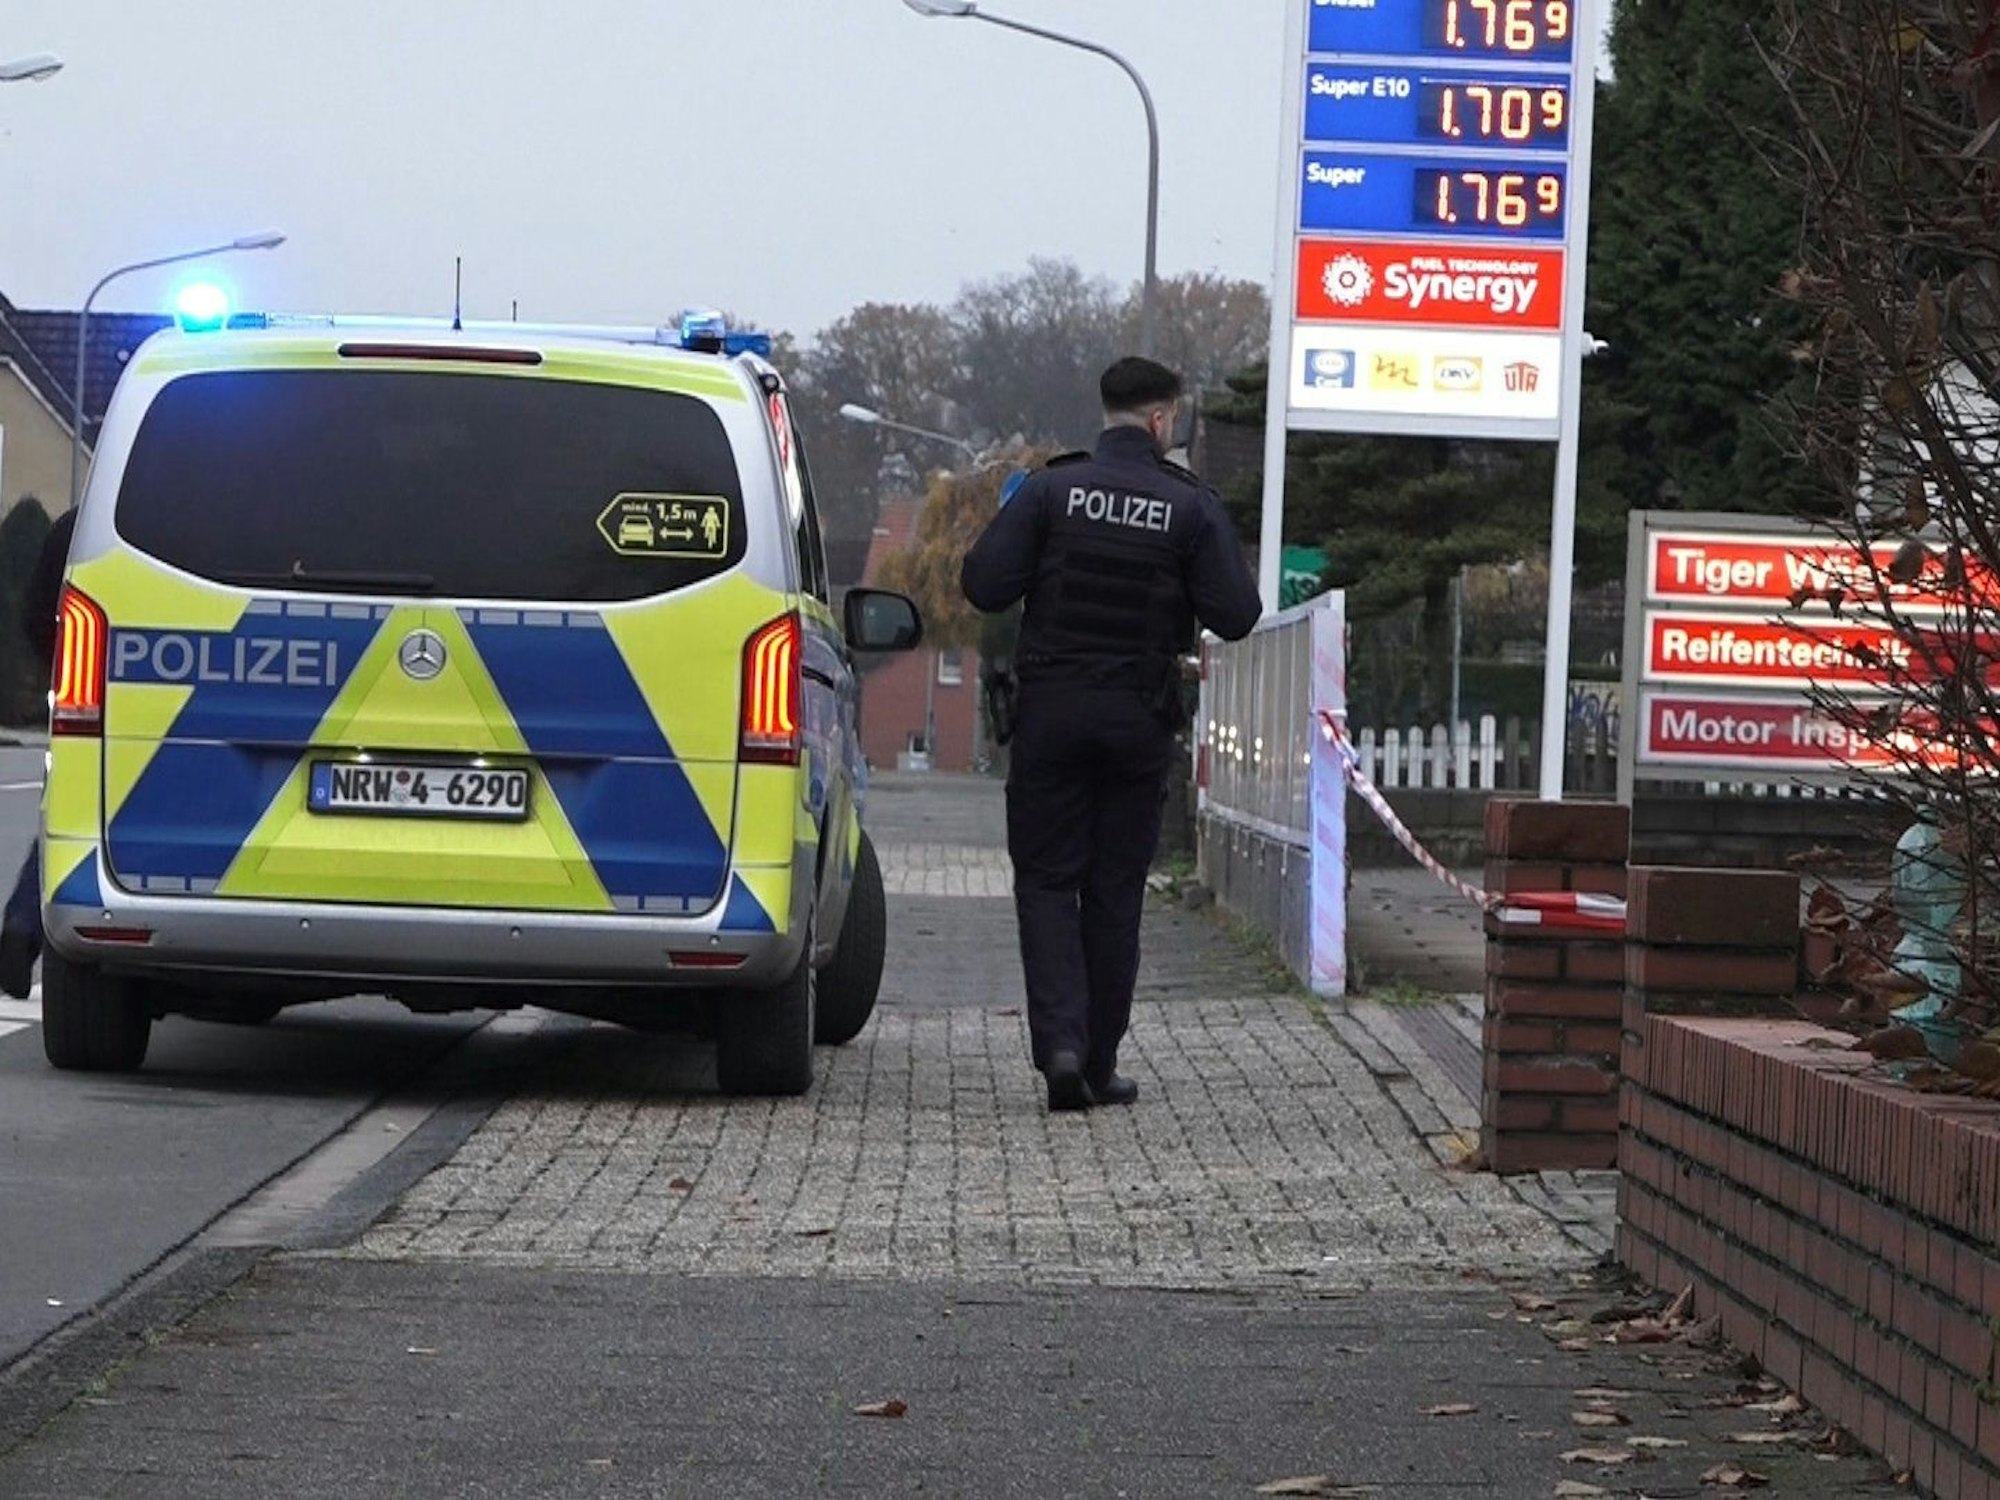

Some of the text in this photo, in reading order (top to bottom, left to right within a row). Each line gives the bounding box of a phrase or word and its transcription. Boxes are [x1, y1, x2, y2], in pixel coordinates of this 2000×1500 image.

[1311, 75, 1410, 99] Super E10
[1307, 163, 1366, 188] Super
[1384, 263, 1538, 314] Synergy
[1503, 361, 1540, 393] UTA
[656, 503, 682, 522] 1,5
[683, 508, 697, 520] m
[1067, 487, 1172, 532] POLIZEI
[1668, 548, 1773, 593] Tiger
[114, 633, 337, 687] POLIZEI
[1661, 709, 1776, 743] Motor
[331, 768, 524, 808] NRW 4-6290
